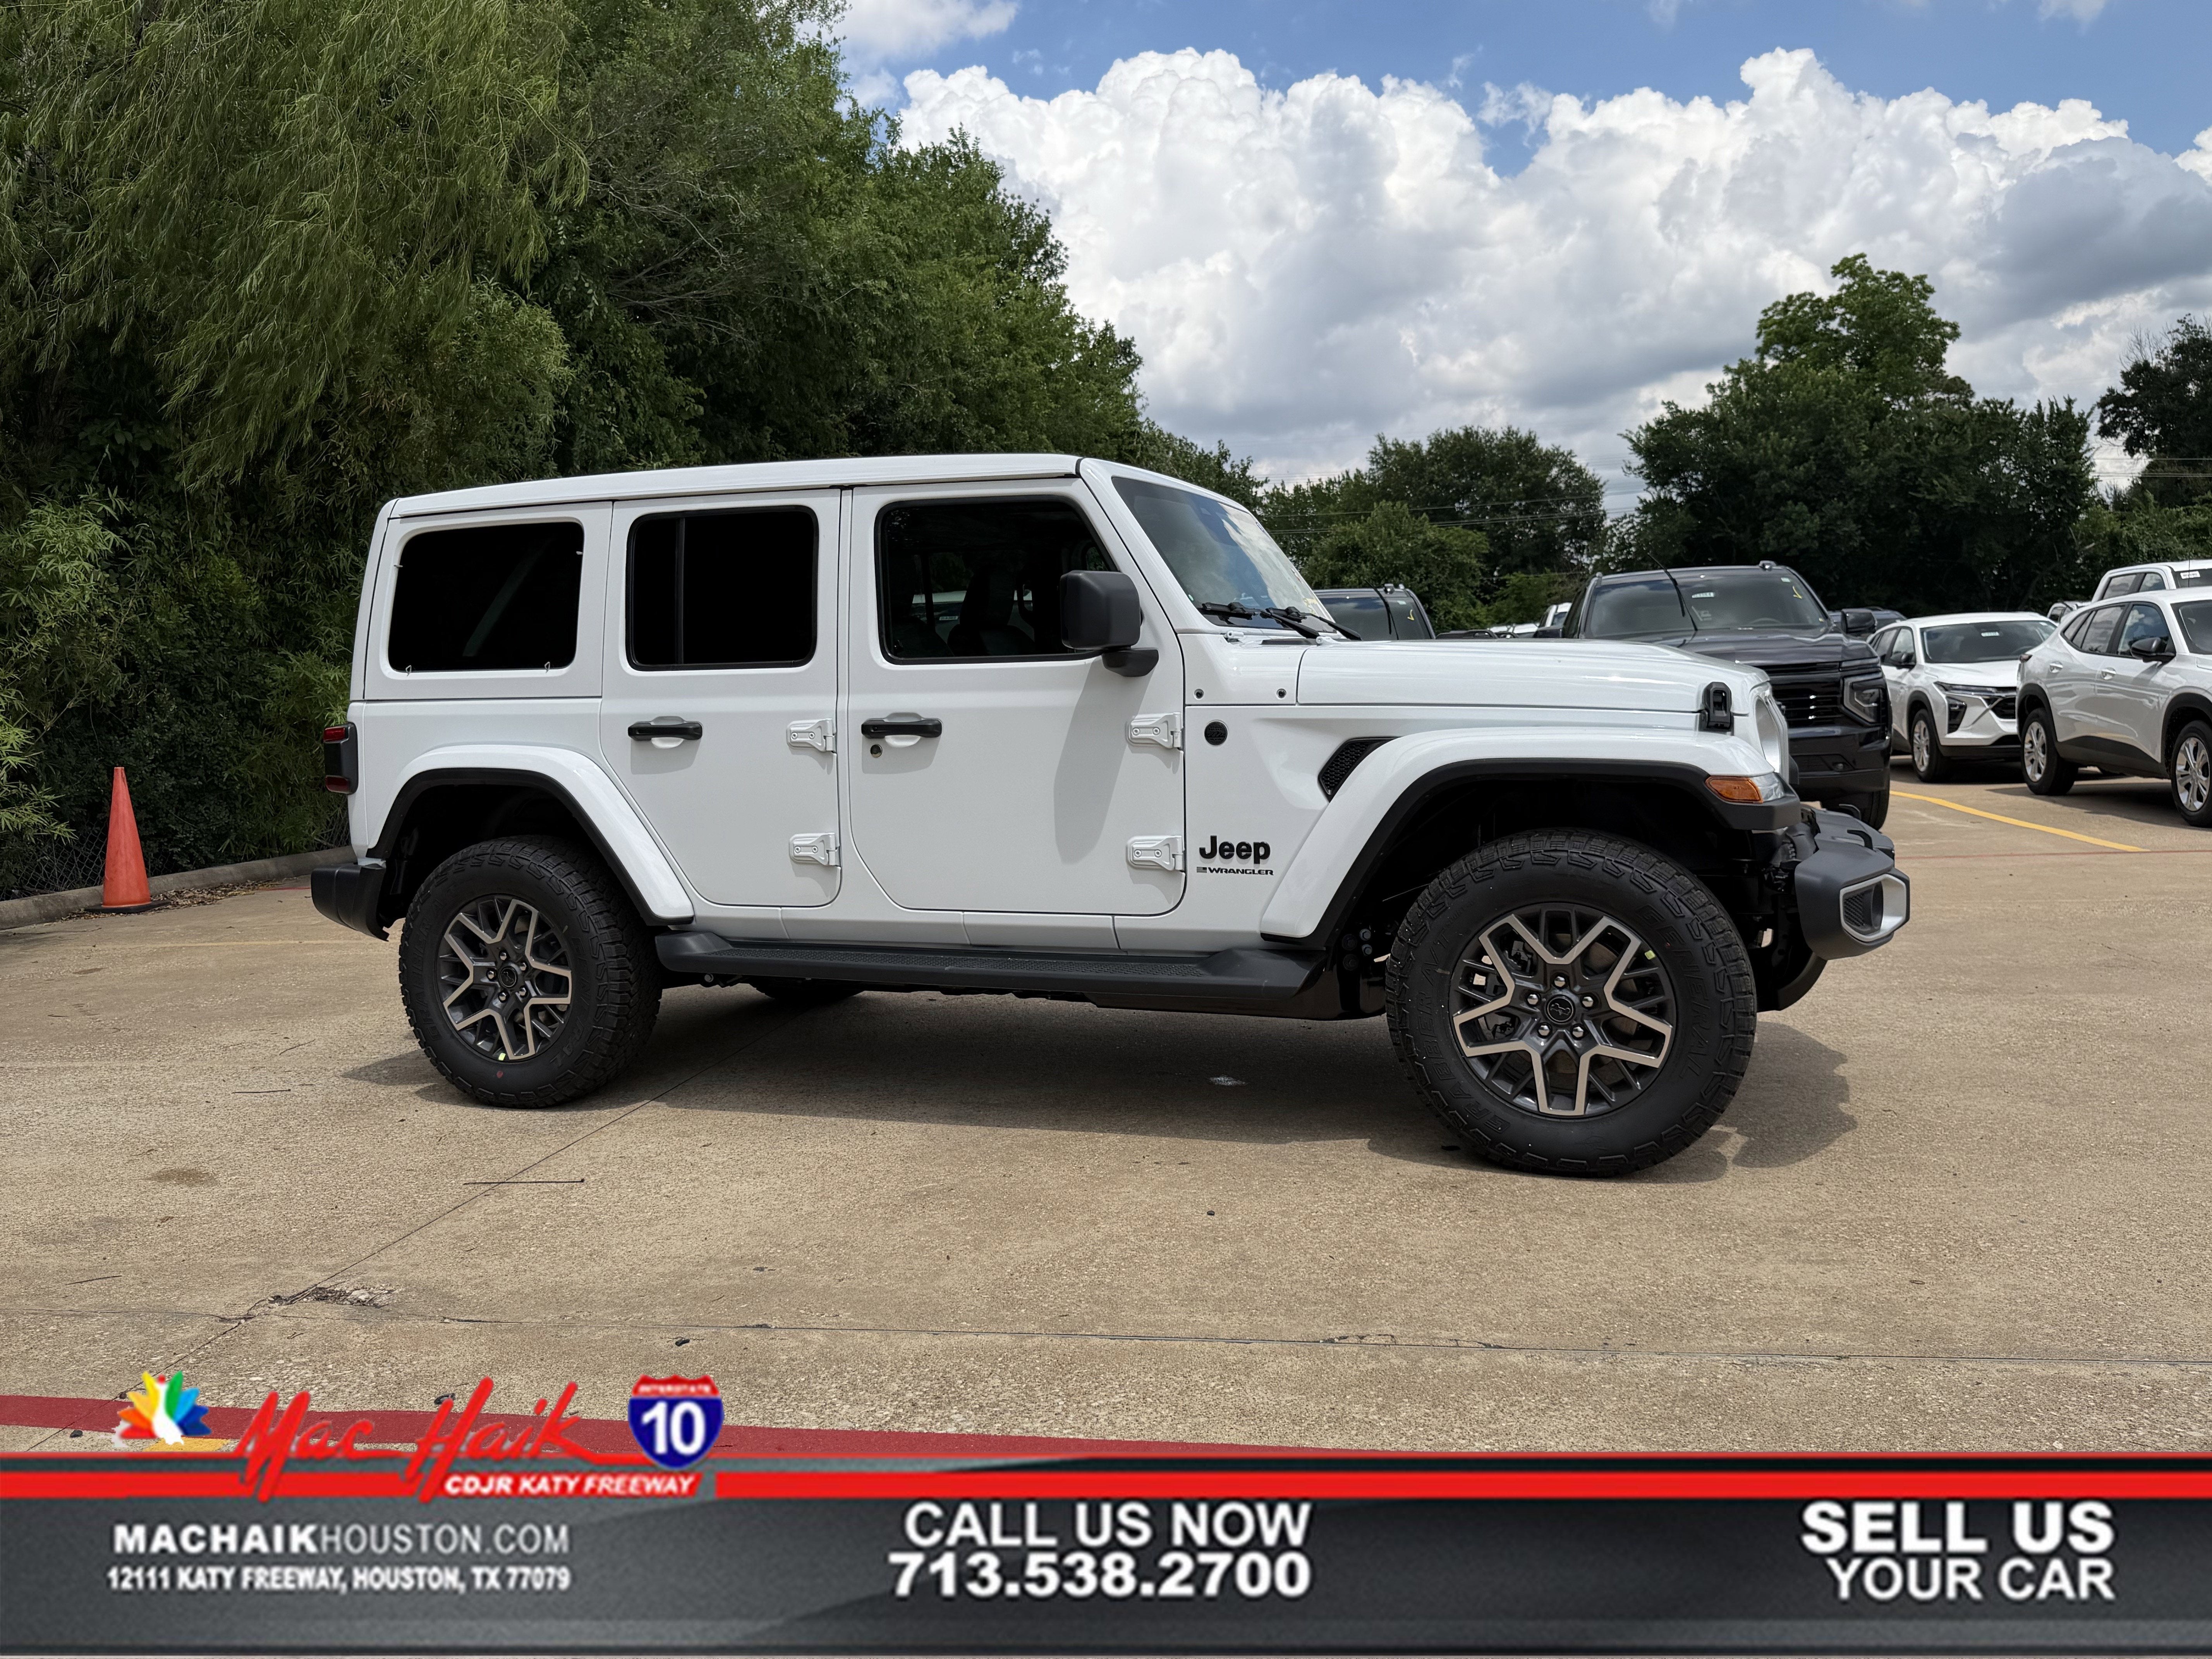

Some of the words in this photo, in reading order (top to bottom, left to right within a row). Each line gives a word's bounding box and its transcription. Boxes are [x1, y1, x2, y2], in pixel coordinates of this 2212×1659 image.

[1199, 835, 1271, 864] Jeep
[1208, 867, 1274, 876] WRANGLER
[1636, 904, 1711, 1080] GENERAL
[1417, 990, 1511, 1133] GRABBER
